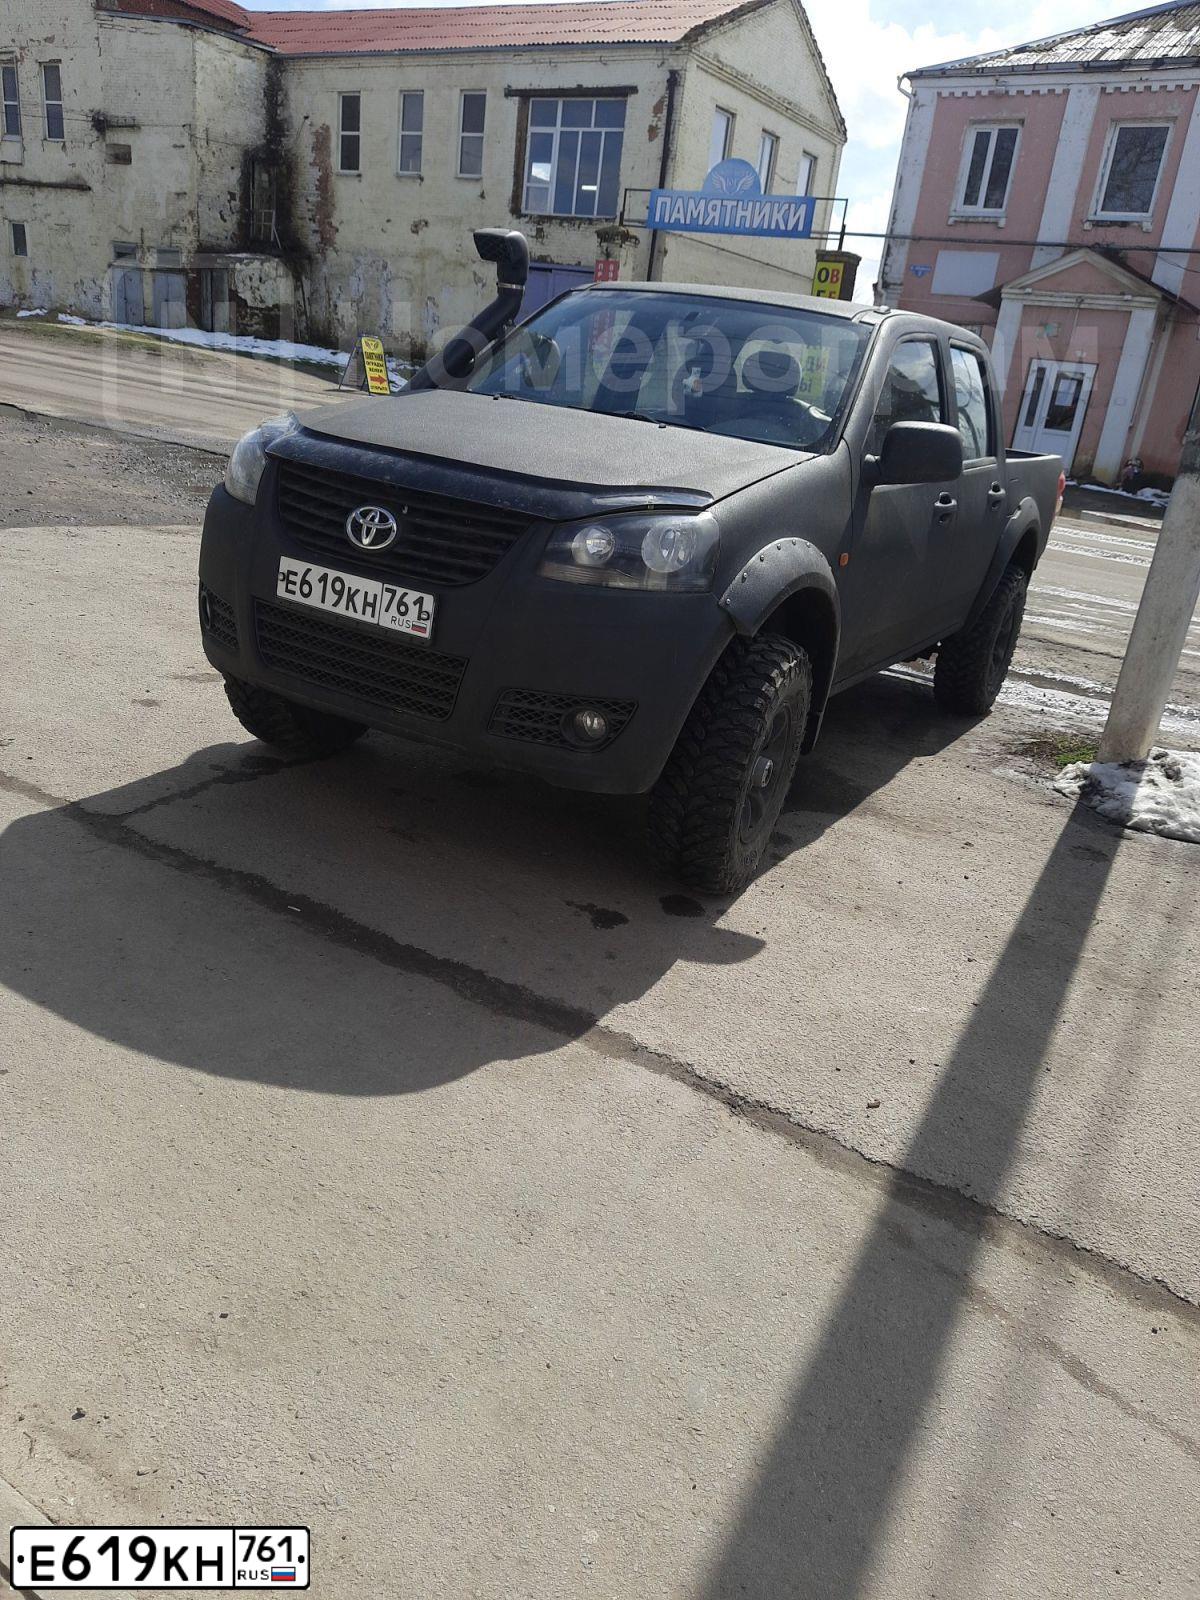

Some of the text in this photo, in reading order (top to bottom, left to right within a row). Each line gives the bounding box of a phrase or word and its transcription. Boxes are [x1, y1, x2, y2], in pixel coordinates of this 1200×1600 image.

[653, 196, 808, 232] ПАМЯТНИКИ
[284, 567, 425, 621] Е619КН 761
[390, 615, 412, 629] RUS
